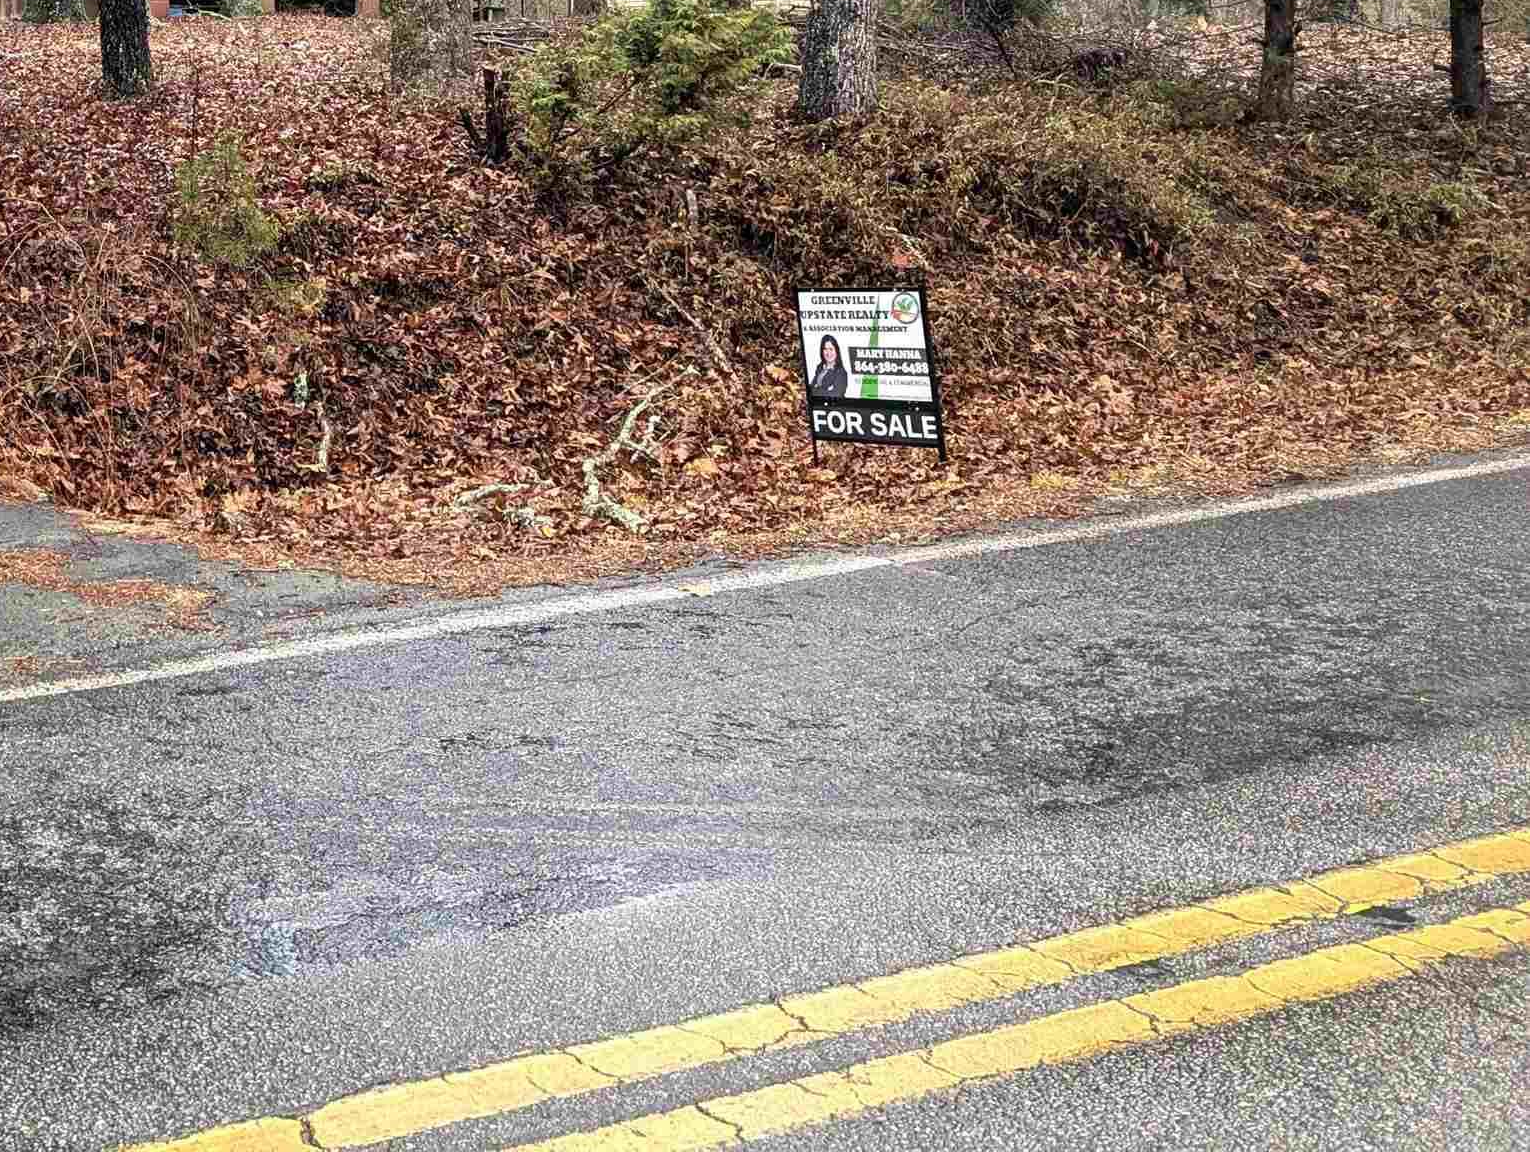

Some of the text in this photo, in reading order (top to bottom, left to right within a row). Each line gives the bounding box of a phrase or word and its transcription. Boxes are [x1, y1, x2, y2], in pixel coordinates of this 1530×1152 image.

[811, 296, 875, 305] GREENVILLE
[800, 310, 889, 319] UPSTATE REALTY
[856, 349, 921, 359] MARY HANNA
[854, 361, 929, 374] 864-380-6488
[813, 410, 938, 439] FOR SALE
